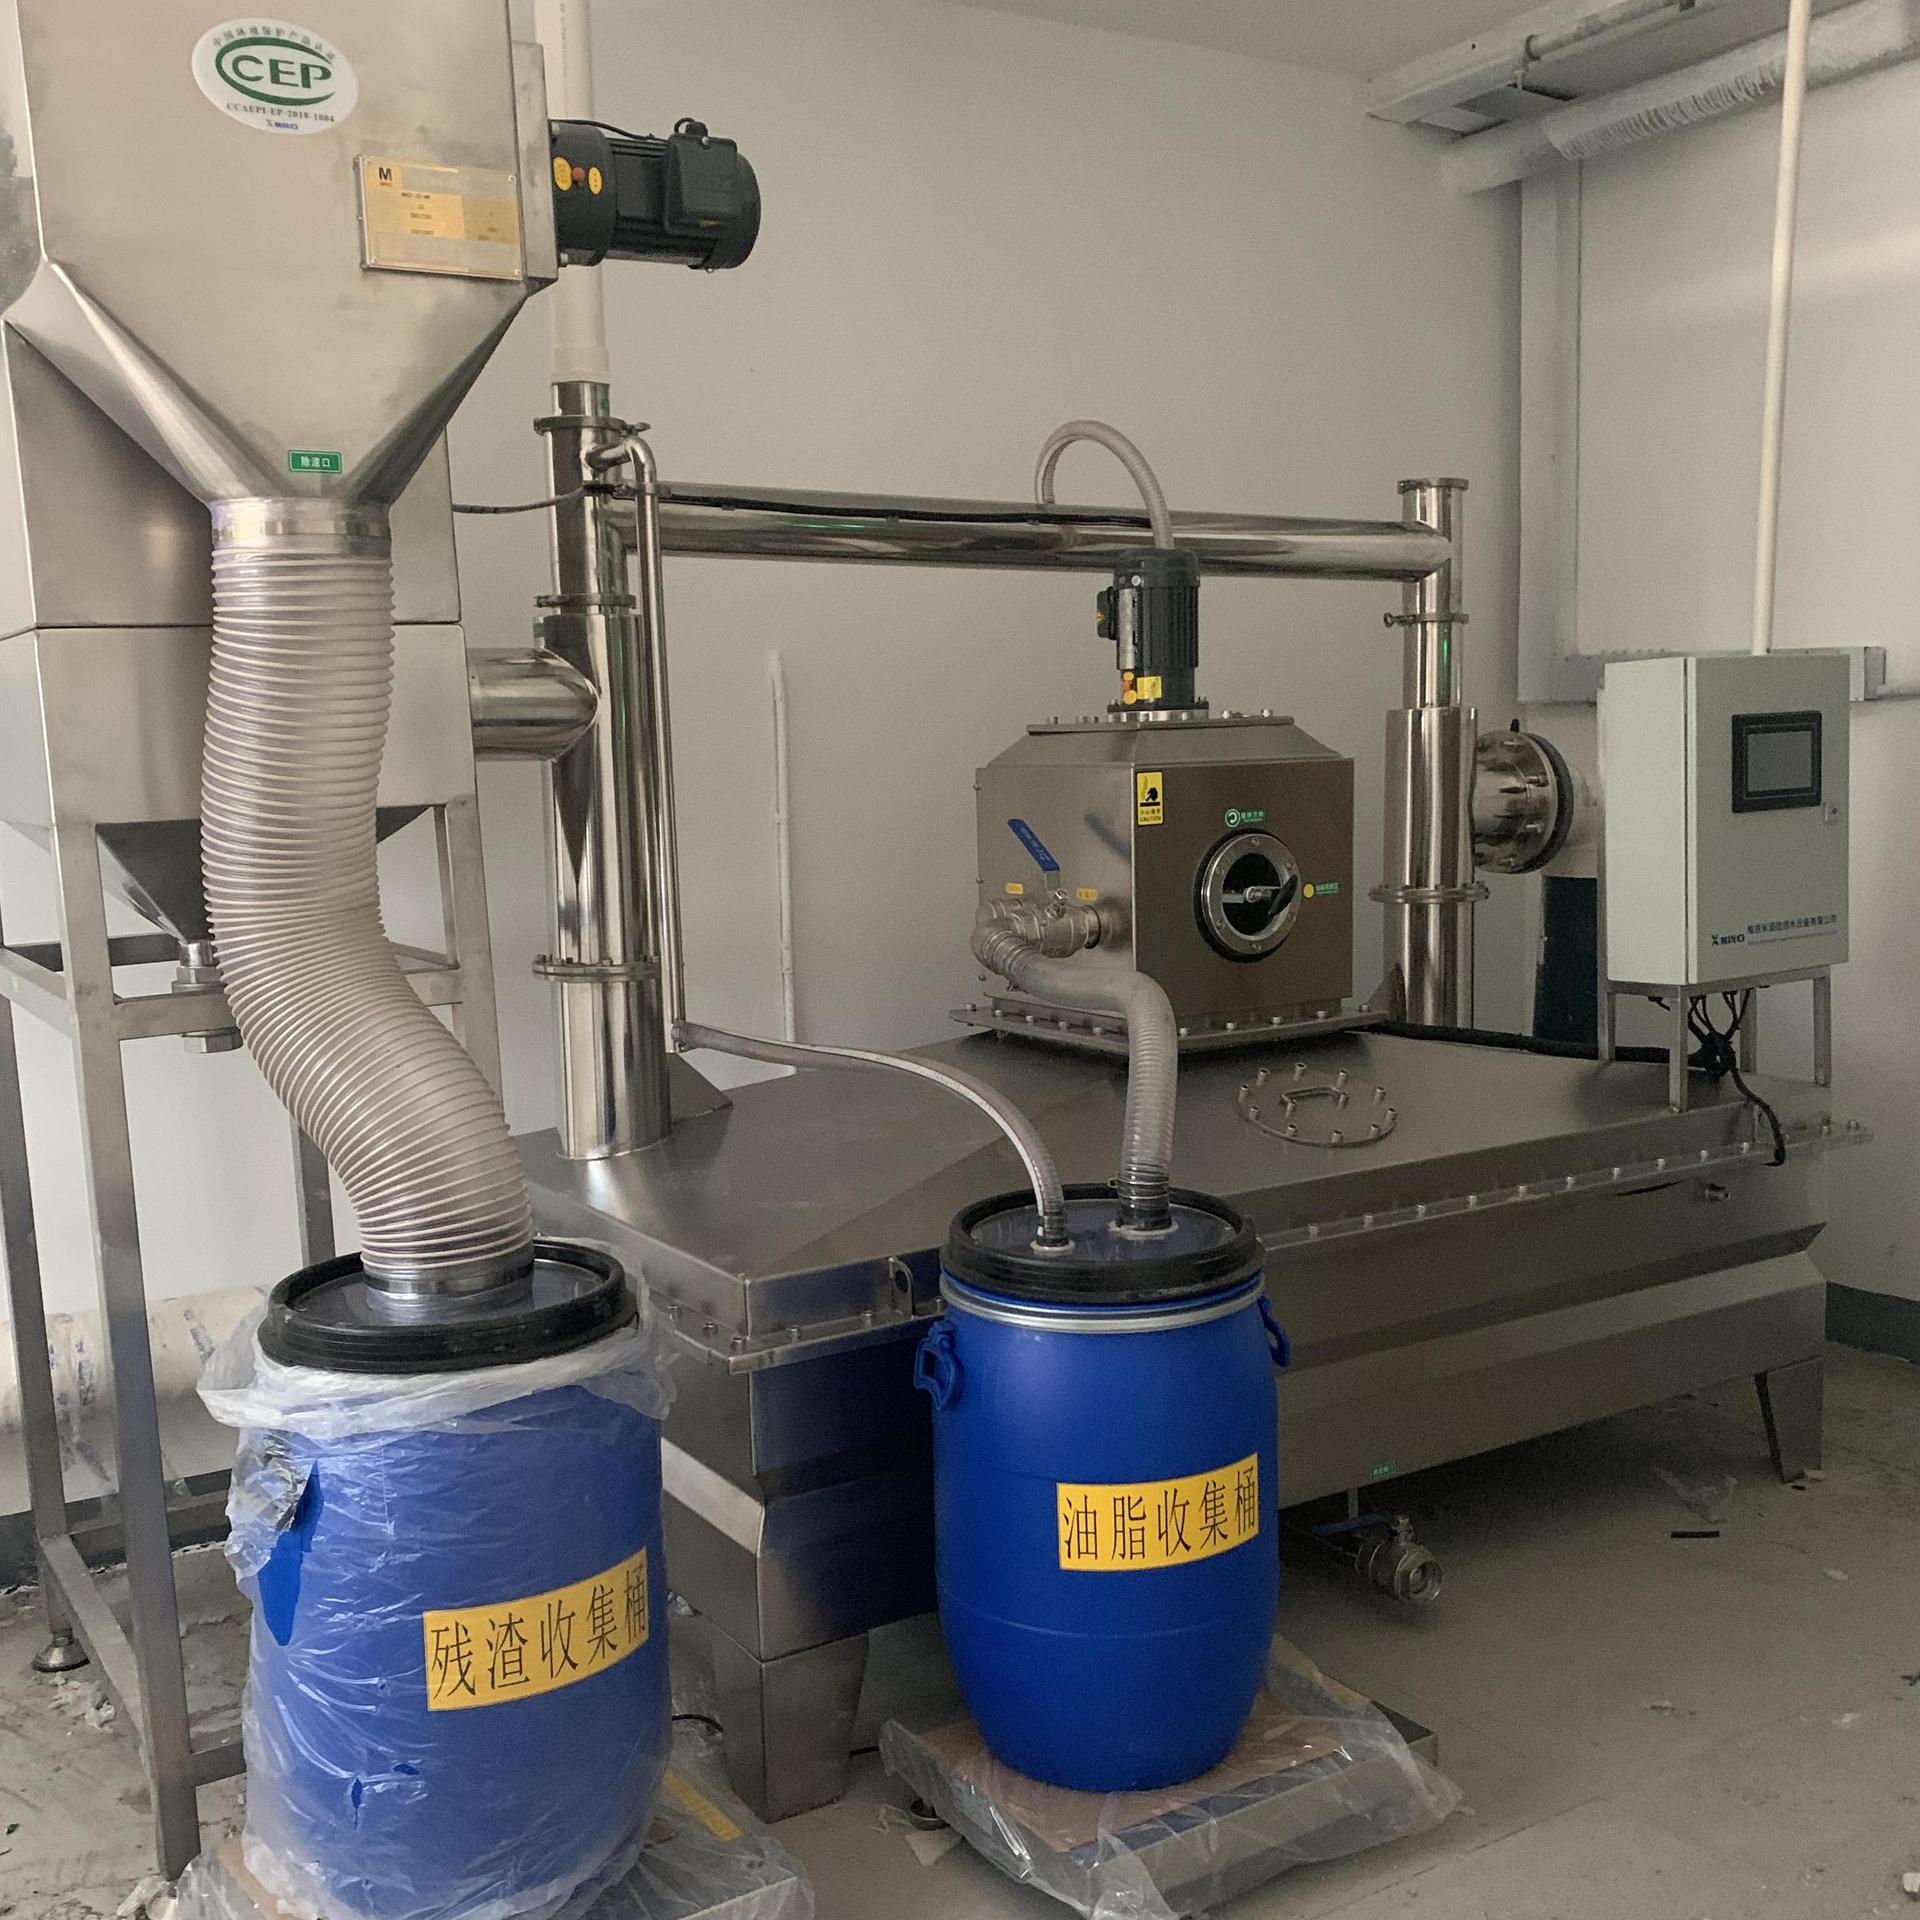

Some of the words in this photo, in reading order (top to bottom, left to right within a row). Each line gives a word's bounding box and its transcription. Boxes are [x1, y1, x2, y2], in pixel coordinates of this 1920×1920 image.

[232, 55, 333, 89] CEP
[378, 166, 393, 181] M
[1720, 933, 1745, 945] MINO
[1063, 1465, 1257, 1562] 油脂收集桶
[430, 1564, 646, 1700] 残渣收集桶
